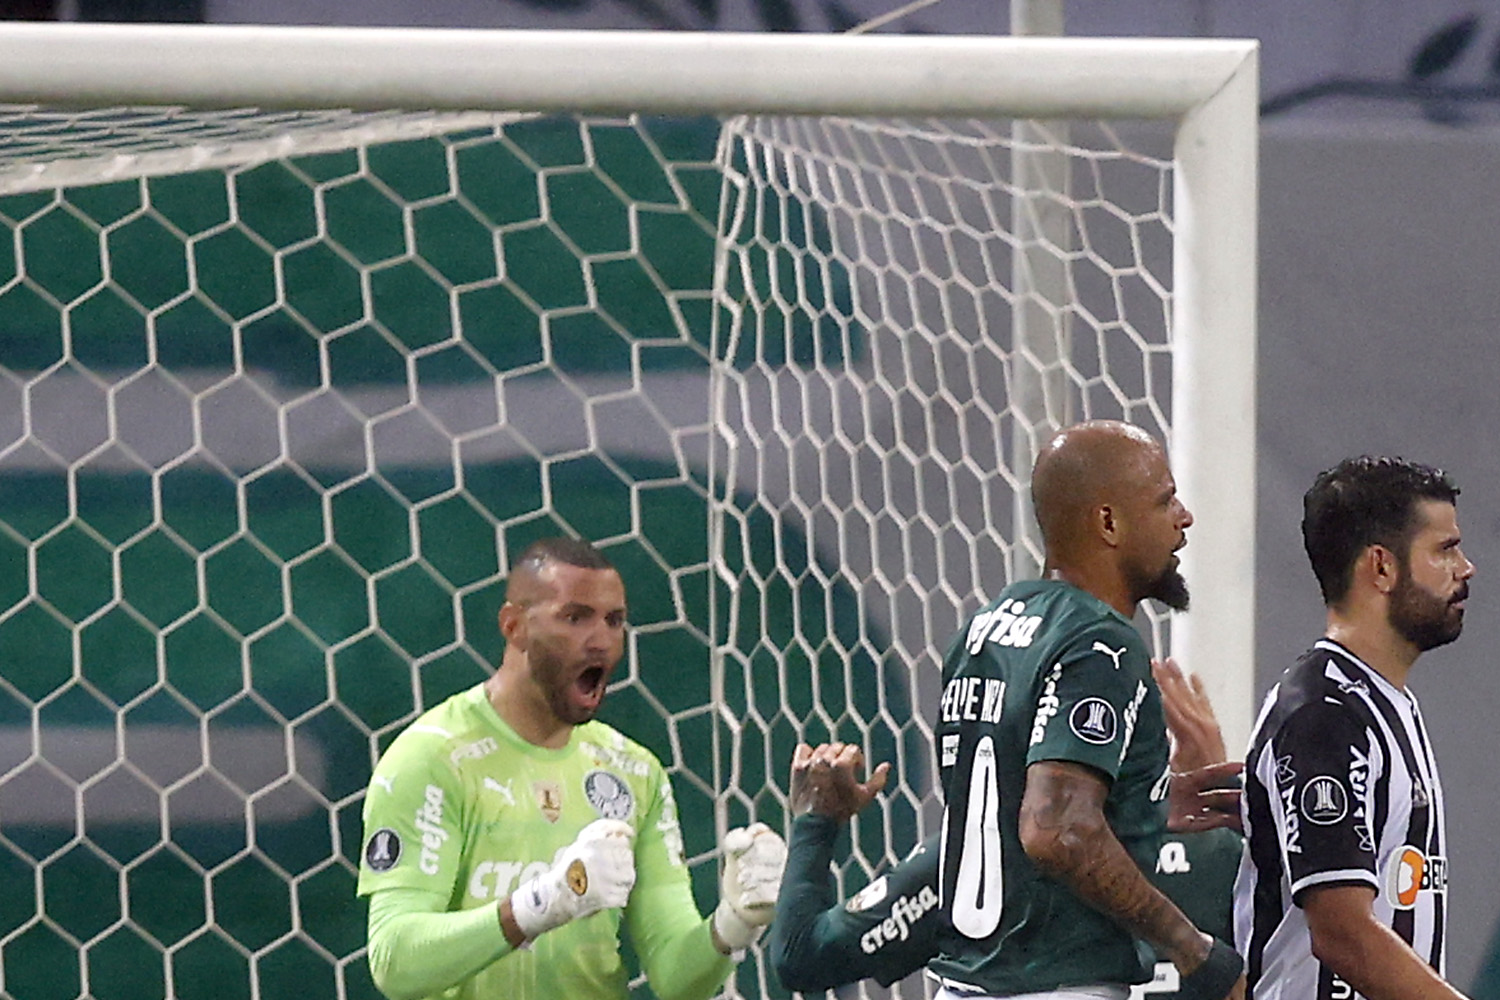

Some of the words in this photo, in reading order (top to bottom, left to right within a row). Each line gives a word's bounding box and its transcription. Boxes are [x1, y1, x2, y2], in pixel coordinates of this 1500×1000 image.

[965, 598, 1044, 655] refisa
[414, 783, 450, 876] crefisa
[1281, 784, 1303, 854] MRV
[860, 885, 939, 955] crefisa
